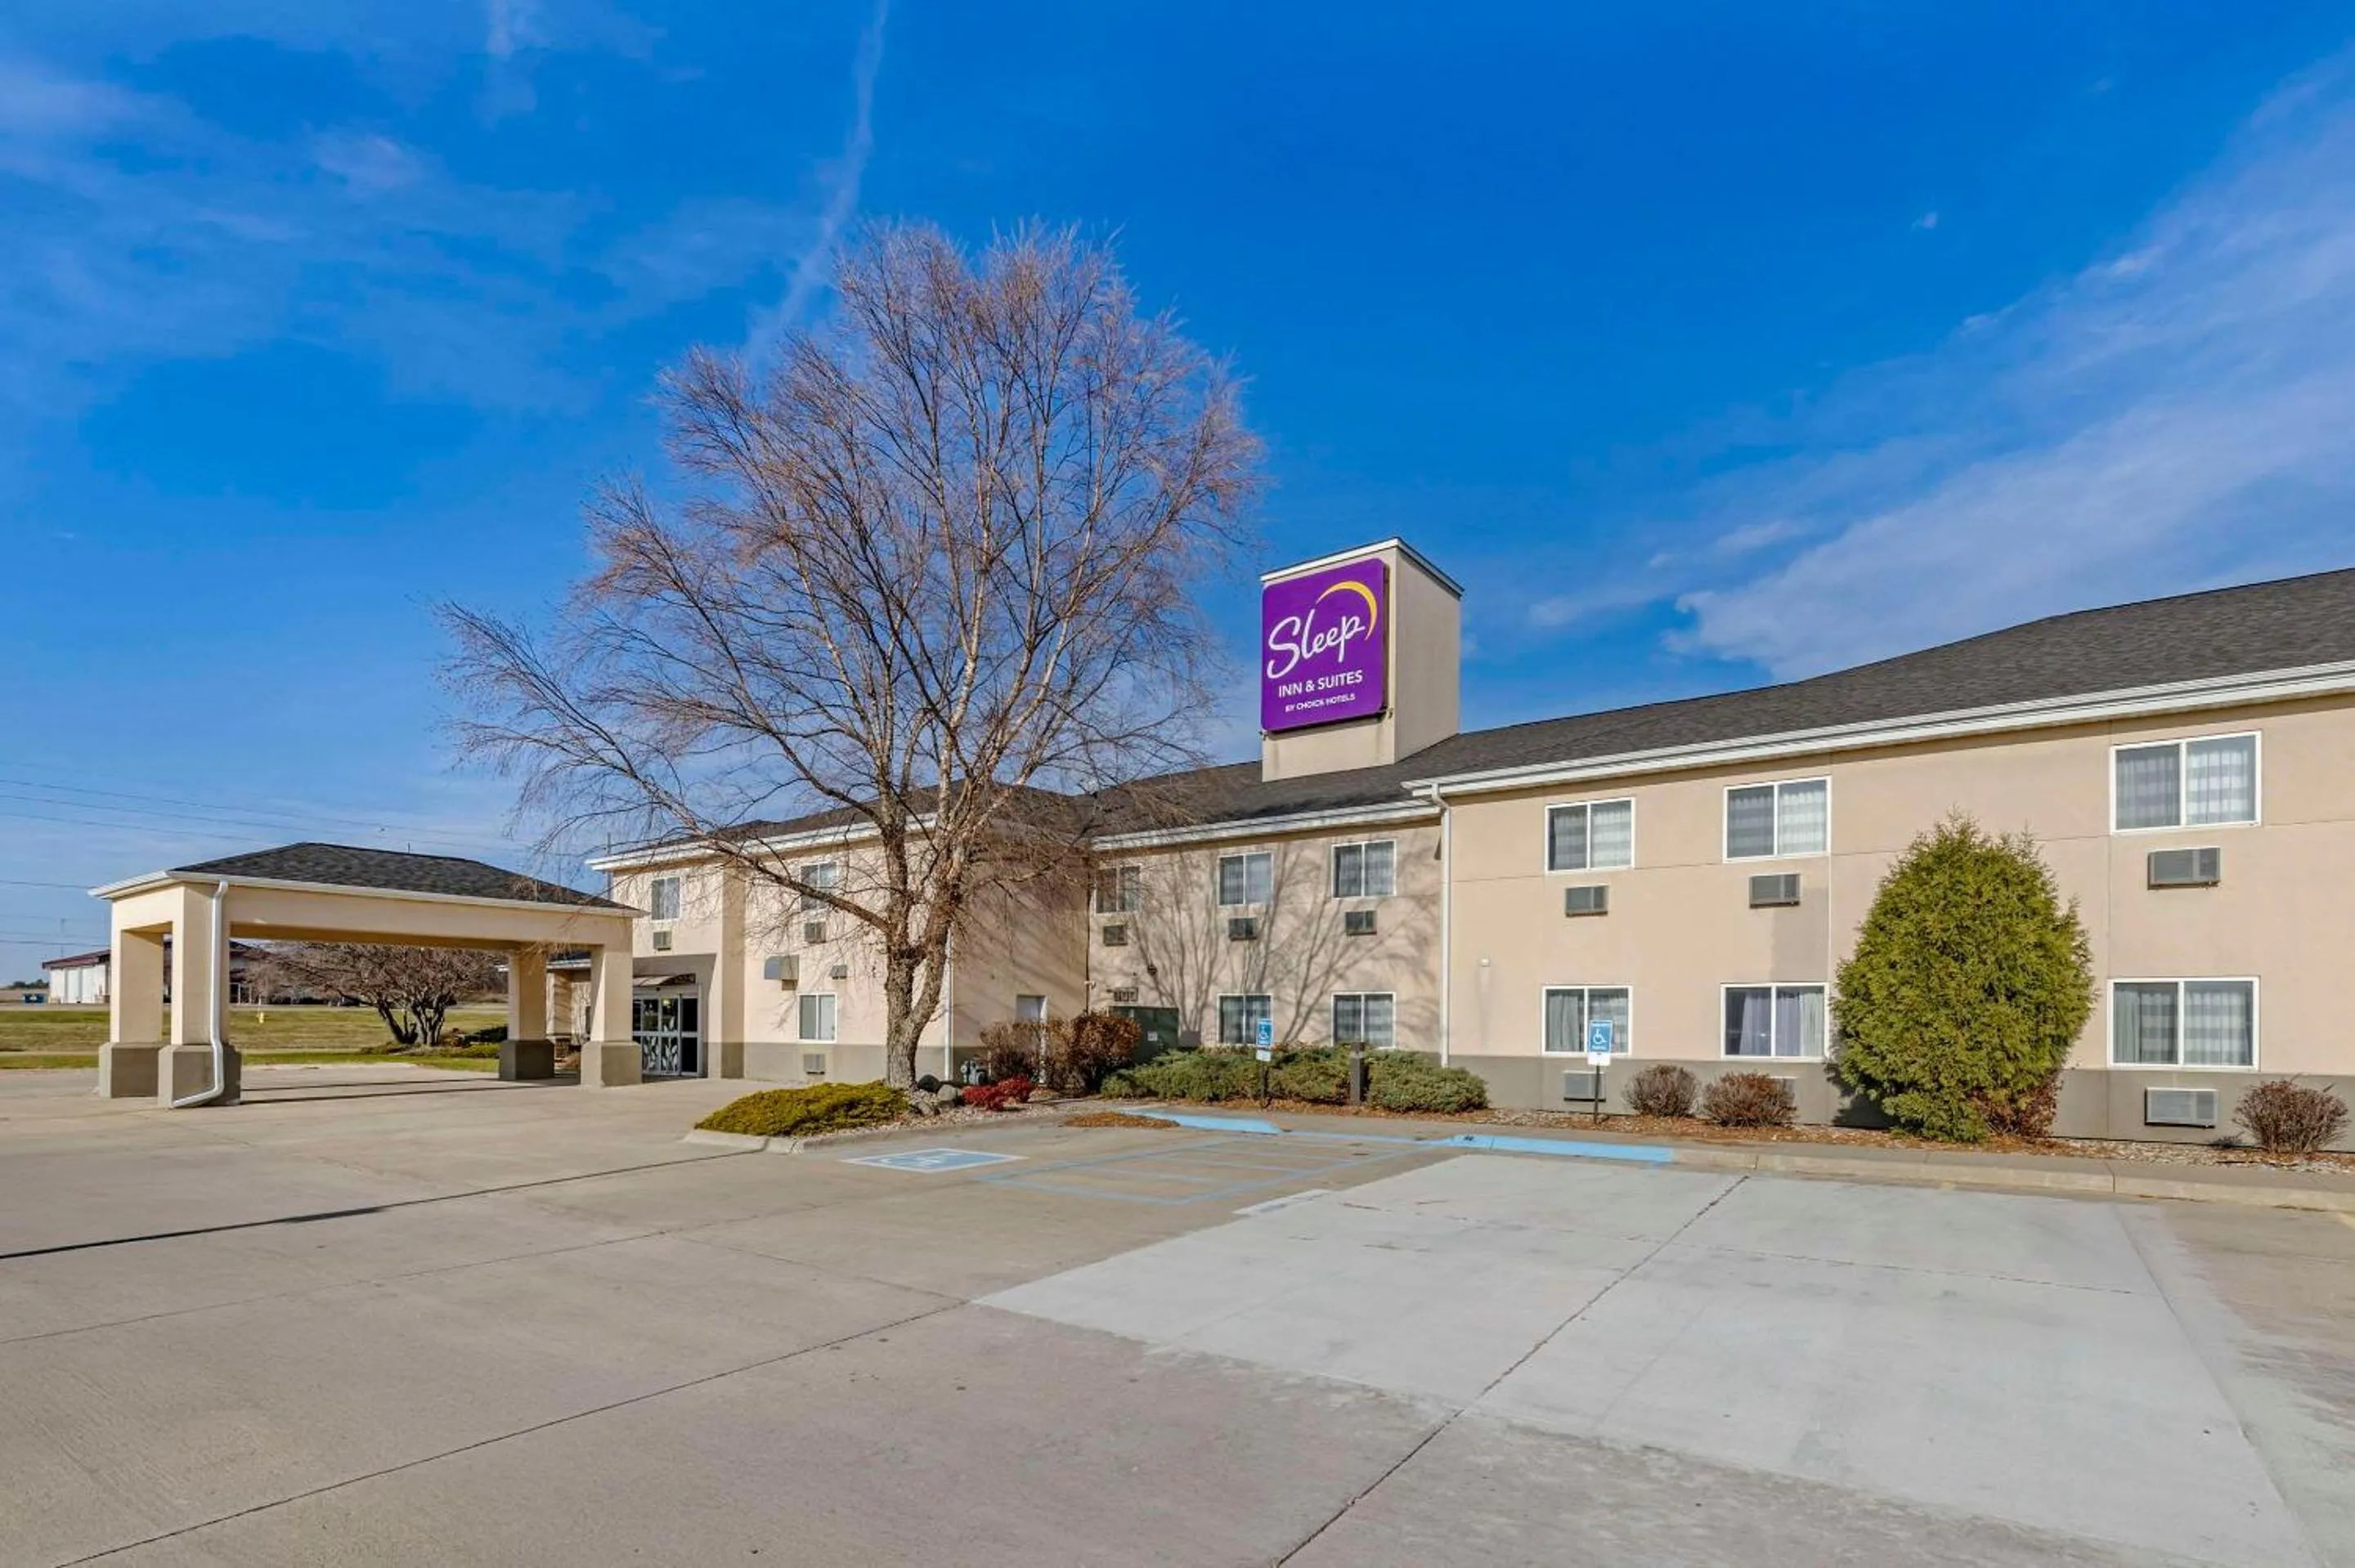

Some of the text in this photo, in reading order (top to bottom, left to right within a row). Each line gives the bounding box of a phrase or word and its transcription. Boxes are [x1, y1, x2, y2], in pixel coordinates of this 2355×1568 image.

[1267, 608, 1366, 679] Sleep
[1279, 670, 1363, 698] INN & SUITES
[1285, 705, 1295, 713] BY
[1326, 693, 1356, 706] HOTELS
